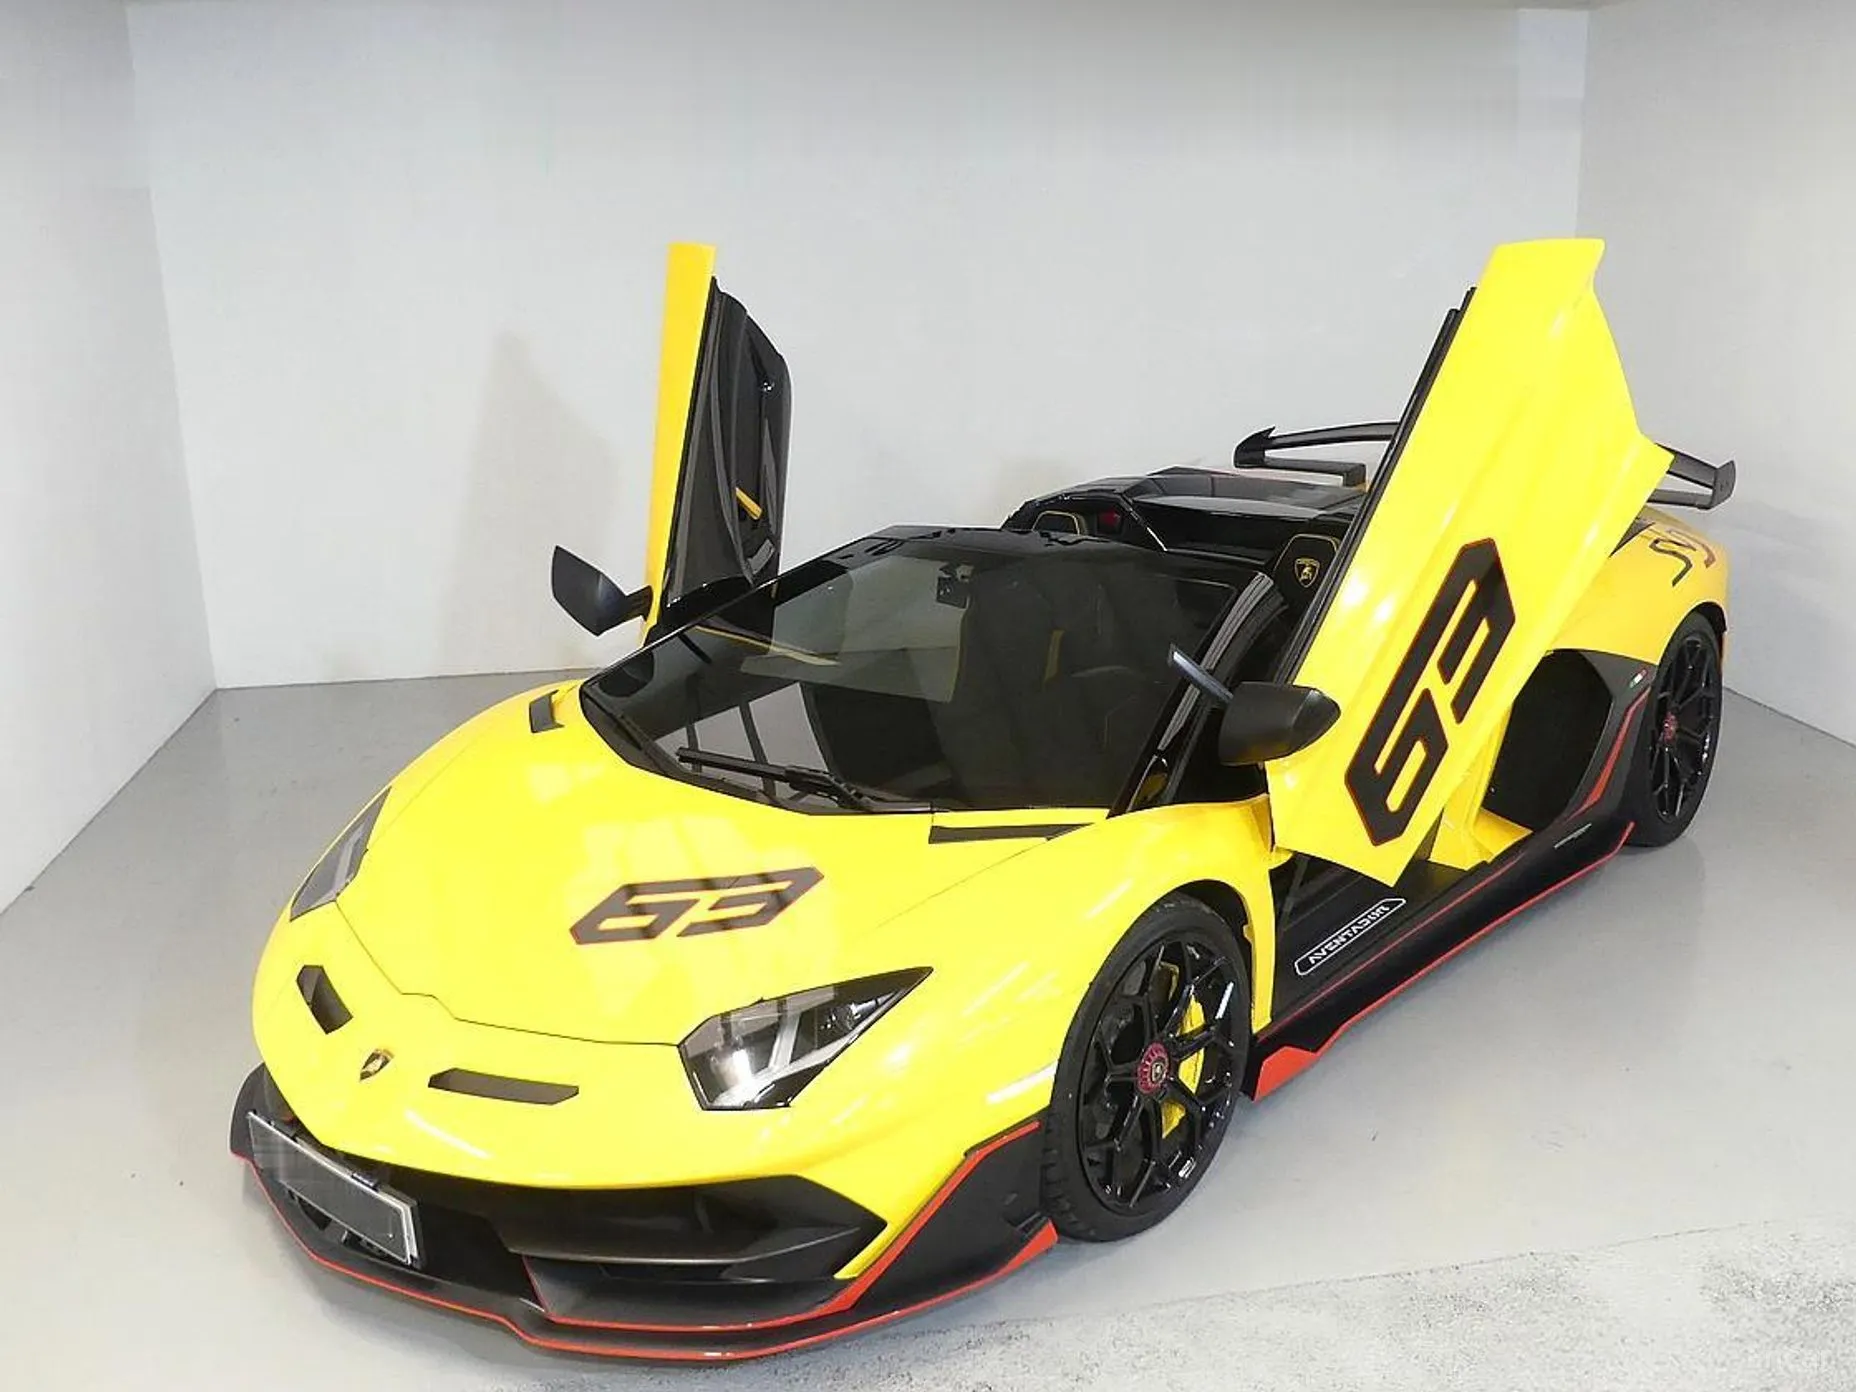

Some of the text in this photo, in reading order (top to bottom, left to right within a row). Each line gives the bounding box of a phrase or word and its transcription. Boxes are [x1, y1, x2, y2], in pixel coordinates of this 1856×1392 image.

[1344, 537, 1516, 847] 63
[570, 866, 824, 945] 63
[1308, 904, 1391, 965] AVENTADOR
